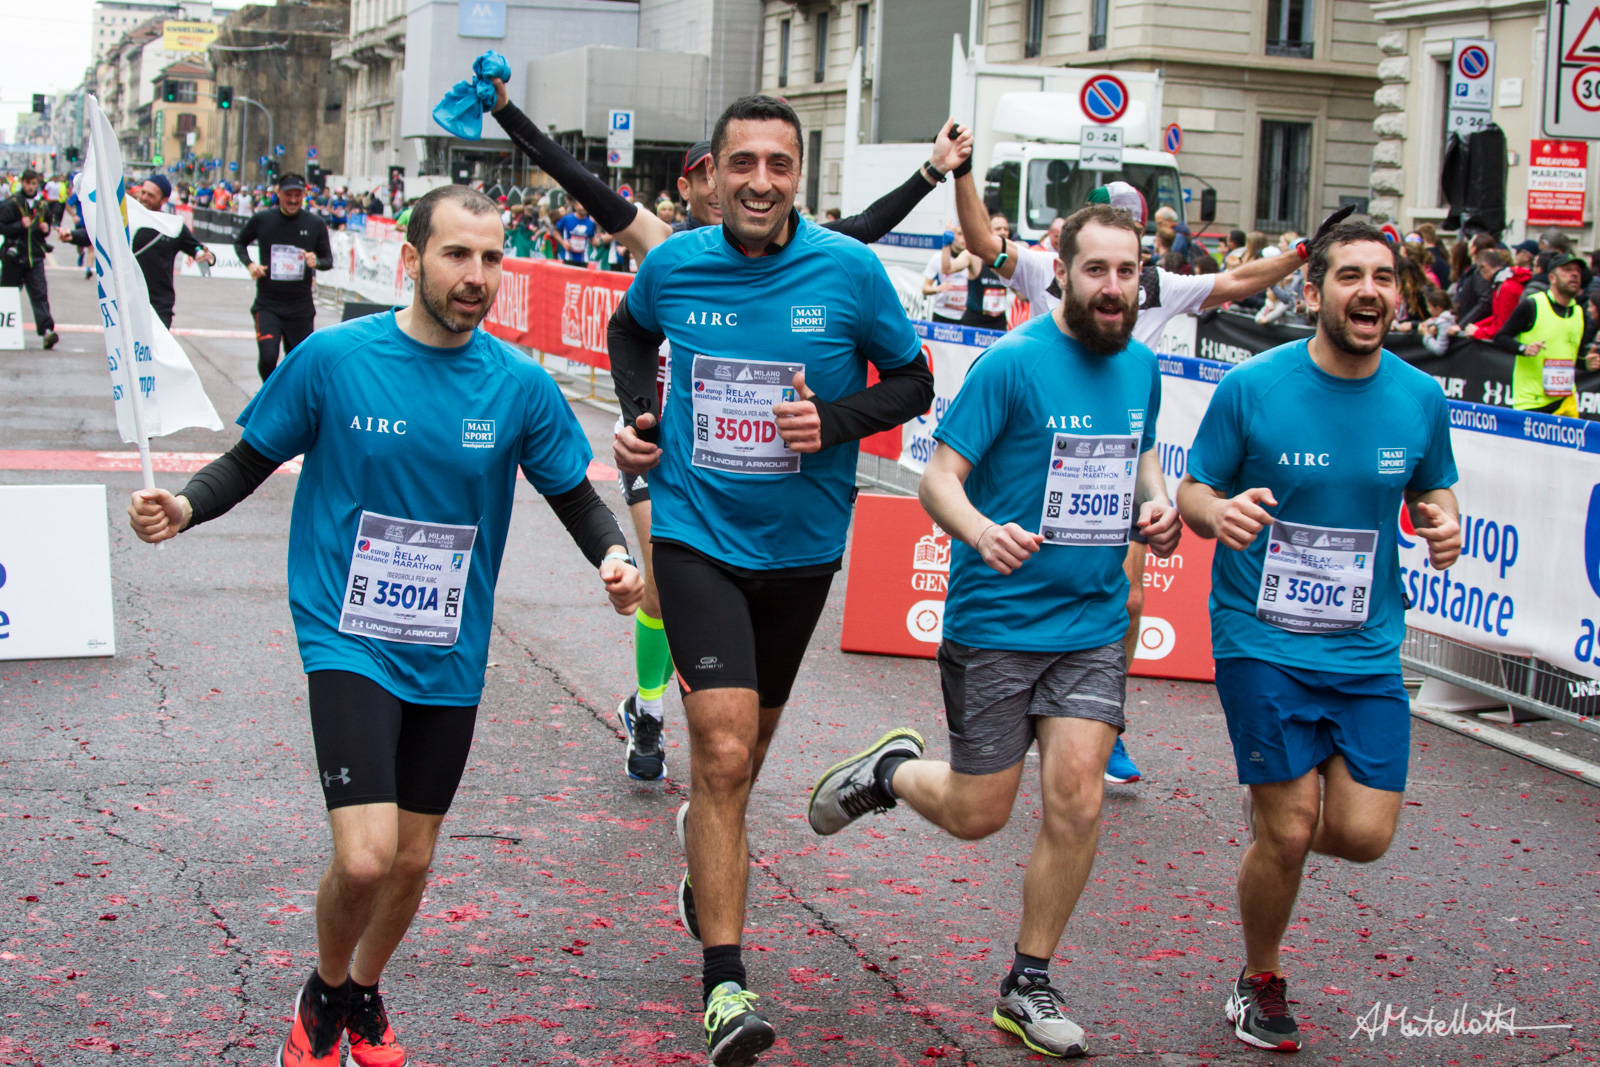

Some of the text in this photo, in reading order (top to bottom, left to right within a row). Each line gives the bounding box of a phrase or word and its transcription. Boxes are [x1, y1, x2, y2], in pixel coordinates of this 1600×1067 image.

[1535, 157, 1580, 167] PREAVVISO
[1531, 170, 1584, 178] MARATONA
[686, 311, 738, 326] AIRC
[793, 317, 824, 325] SPORT
[753, 369, 780, 377] MILANO
[1550, 375, 1569, 386] 3524
[694, 393, 723, 402] assistance
[705, 388, 723, 396] europ
[725, 388, 757, 399] RELAY
[725, 396, 773, 406] MARATHON
[722, 407, 747, 417] IBERDROLA
[350, 415, 407, 435] AIRC
[467, 422, 491, 432] MAXI
[1045, 415, 1092, 429] AIRC
[714, 416, 777, 443] 3501D
[1523, 416, 1586, 447] #corricon
[464, 432, 494, 441] SPORT
[712, 456, 743, 467] UNDER
[745, 460, 790, 468] ARMOUR
[1278, 453, 1330, 466] AIRC
[1068, 493, 1120, 516] 3501B
[428, 532, 455, 541] MILANO
[1061, 531, 1092, 540] UNDER
[370, 548, 390, 558] europ
[393, 550, 428, 563] RELAY
[1301, 553, 1333, 563] RELAY
[355, 553, 389, 565] assistance
[392, 559, 442, 571] MARATHON
[1300, 560, 1345, 571] MARATHON
[386, 571, 415, 582] IBERDROLA
[415, 575, 426, 583] PER
[372, 579, 438, 611] 3501A
[1285, 577, 1347, 607] 3501C
[1277, 615, 1311, 627] UNDER
[365, 622, 402, 636] UNDER
[403, 630, 450, 639] ARMOUR
